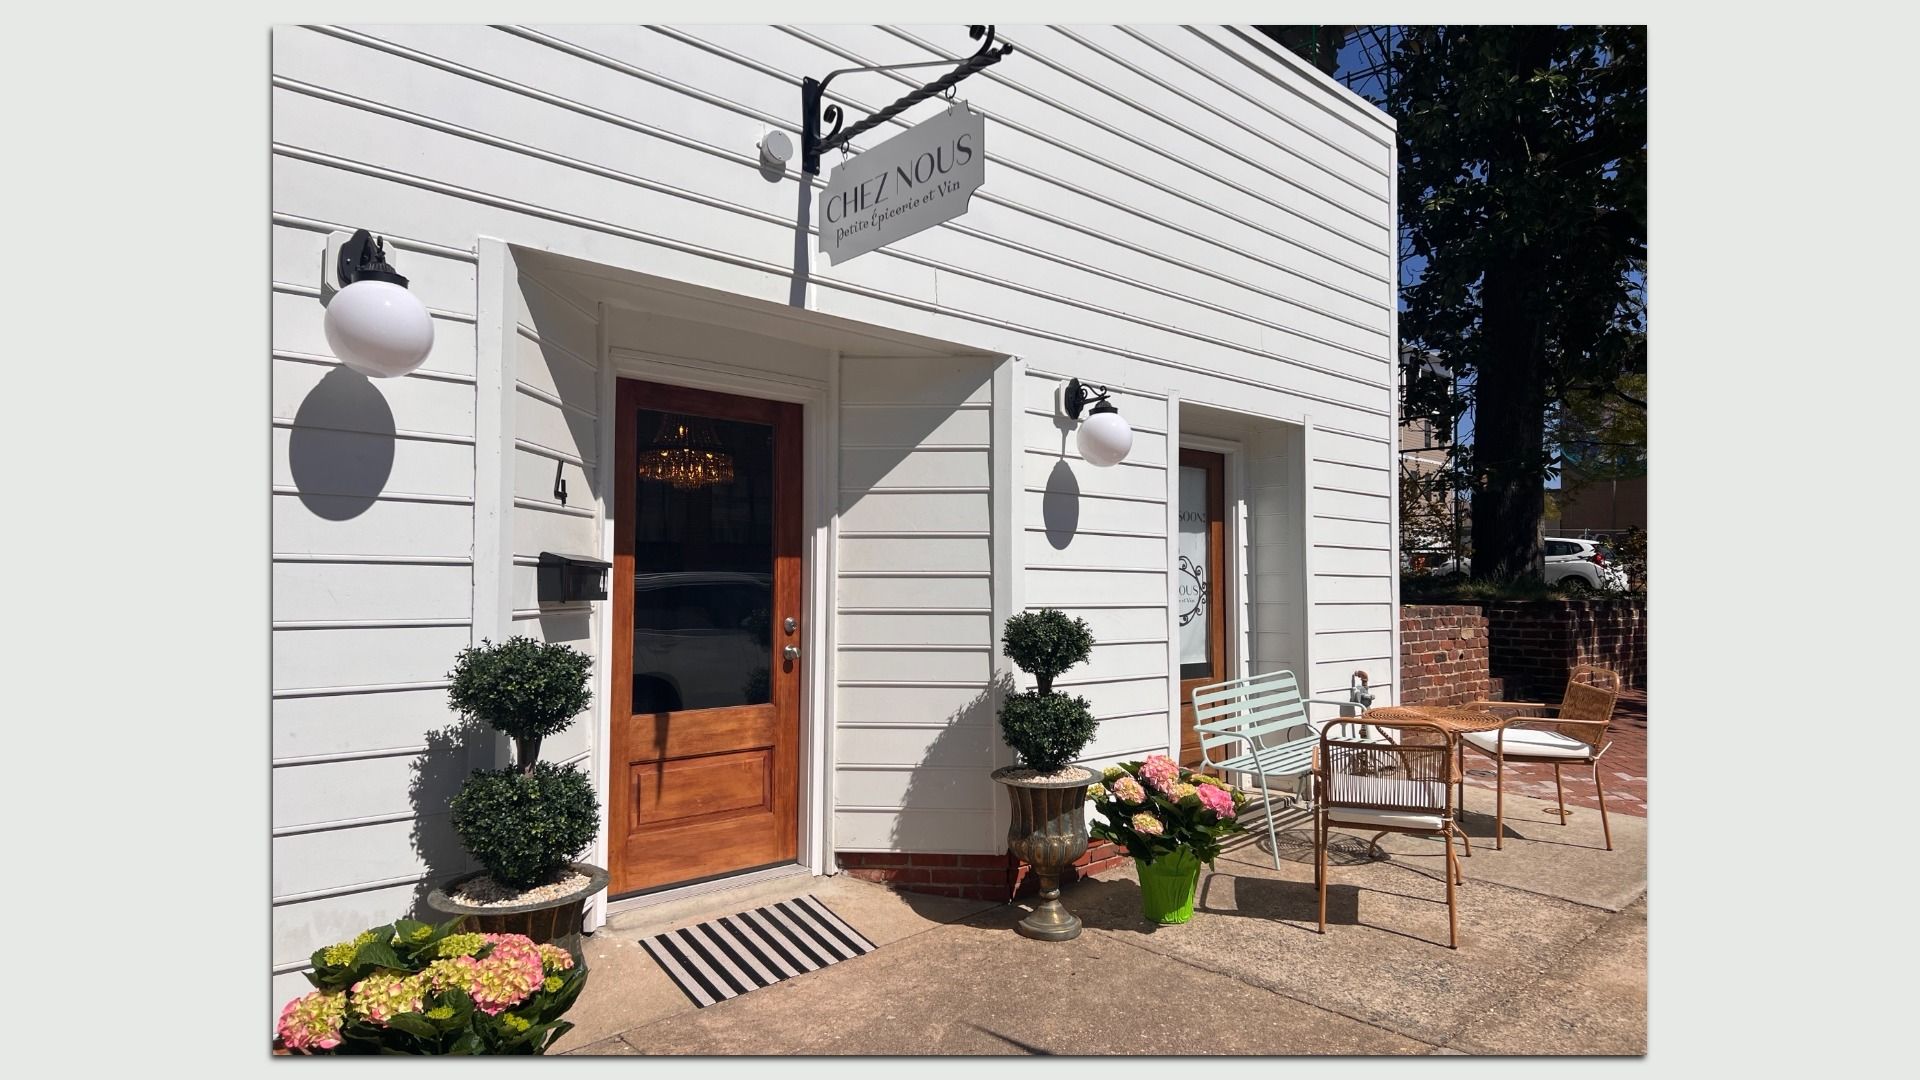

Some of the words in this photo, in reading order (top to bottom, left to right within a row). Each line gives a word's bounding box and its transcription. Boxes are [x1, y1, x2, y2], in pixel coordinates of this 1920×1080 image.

[826, 171, 889, 224] CHEZ
[896, 133, 972, 195] NOUS
[923, 189, 936, 204] et
[937, 180, 960, 197] Vin
[554, 460, 568, 506] 4
[1178, 584, 1198, 595] OUS
